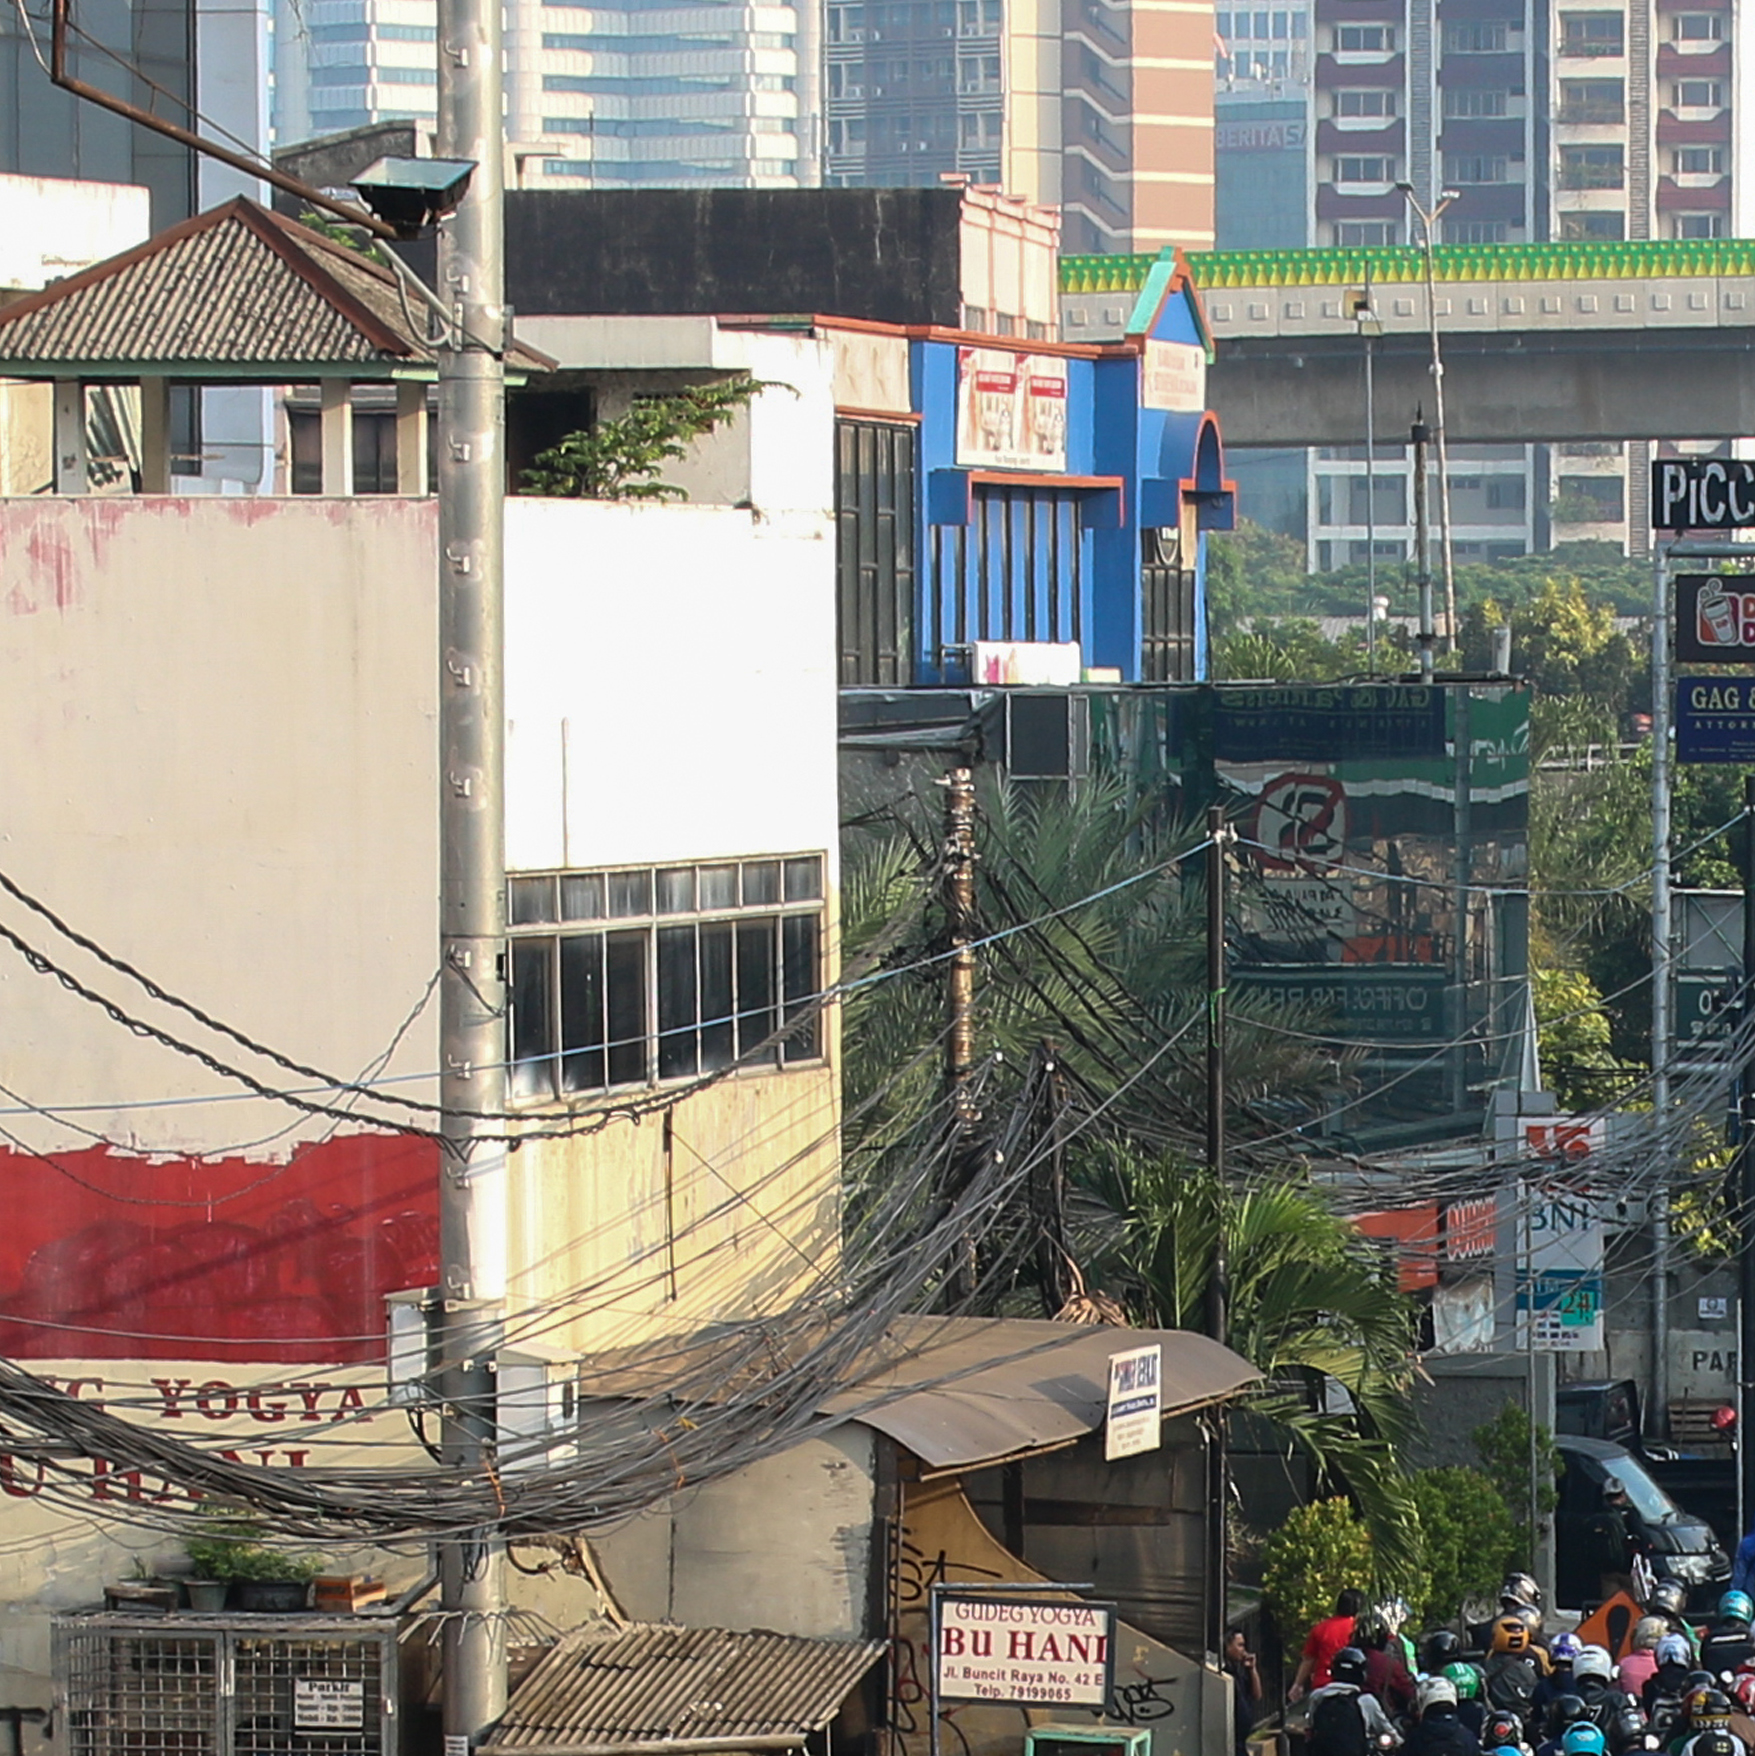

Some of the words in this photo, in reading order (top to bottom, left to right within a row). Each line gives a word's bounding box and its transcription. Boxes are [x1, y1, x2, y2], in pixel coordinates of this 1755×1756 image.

[1691, 687, 1740, 709] GAG
[151, 1379, 373, 1423] YOGYA
[955, 1602, 1024, 1623] GUDEG
[1029, 1606, 1097, 1627] YOGYA
[941, 1627, 993, 1657] BU
[1007, 1630, 1107, 1664] HANI
[962, 1667, 1007, 1682] Buncit
[1010, 1669, 1044, 1686] Raya
[1048, 1672, 1070, 1685] No.
[1074, 1673, 1090, 1686] 42
[1094, 1674, 1104, 1687] E
[974, 1683, 1005, 1699] Telp.
[1009, 1686, 1072, 1701] 79199065
